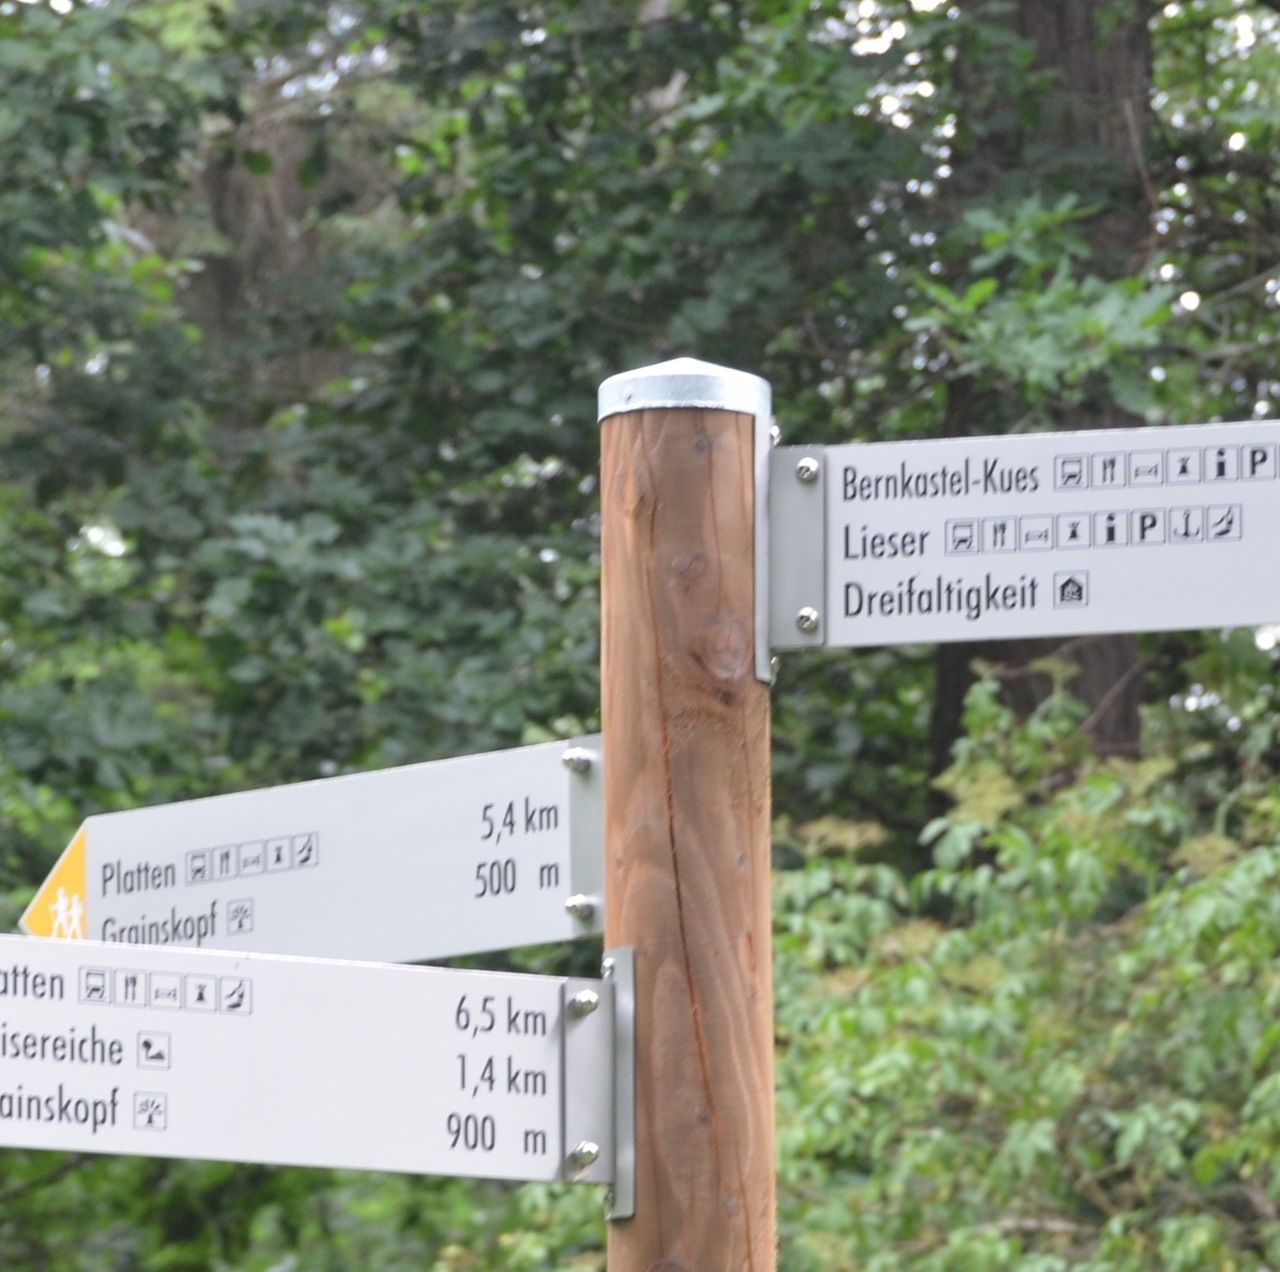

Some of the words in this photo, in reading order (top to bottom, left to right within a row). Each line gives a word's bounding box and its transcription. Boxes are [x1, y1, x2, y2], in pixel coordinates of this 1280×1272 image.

[842, 456, 1040, 502] Bernkastel-Kues
[843, 522, 931, 561] Lieser
[843, 571, 1040, 621] Dreifaltigkeit
[101, 859, 176, 898] Platten
[480, 802, 516, 844] 5,4
[524, 796, 559, 833] km
[101, 899, 218, 947] Grainskopf
[474, 858, 517, 899] 500
[538, 862, 560, 890] m
[454, 994, 496, 1038] 6,5
[506, 995, 548, 1037] km
[455, 1053, 497, 1096] 1,4
[506, 1055, 548, 1098] km
[446, 1112, 497, 1154] 900
[523, 1128, 548, 1156] m
